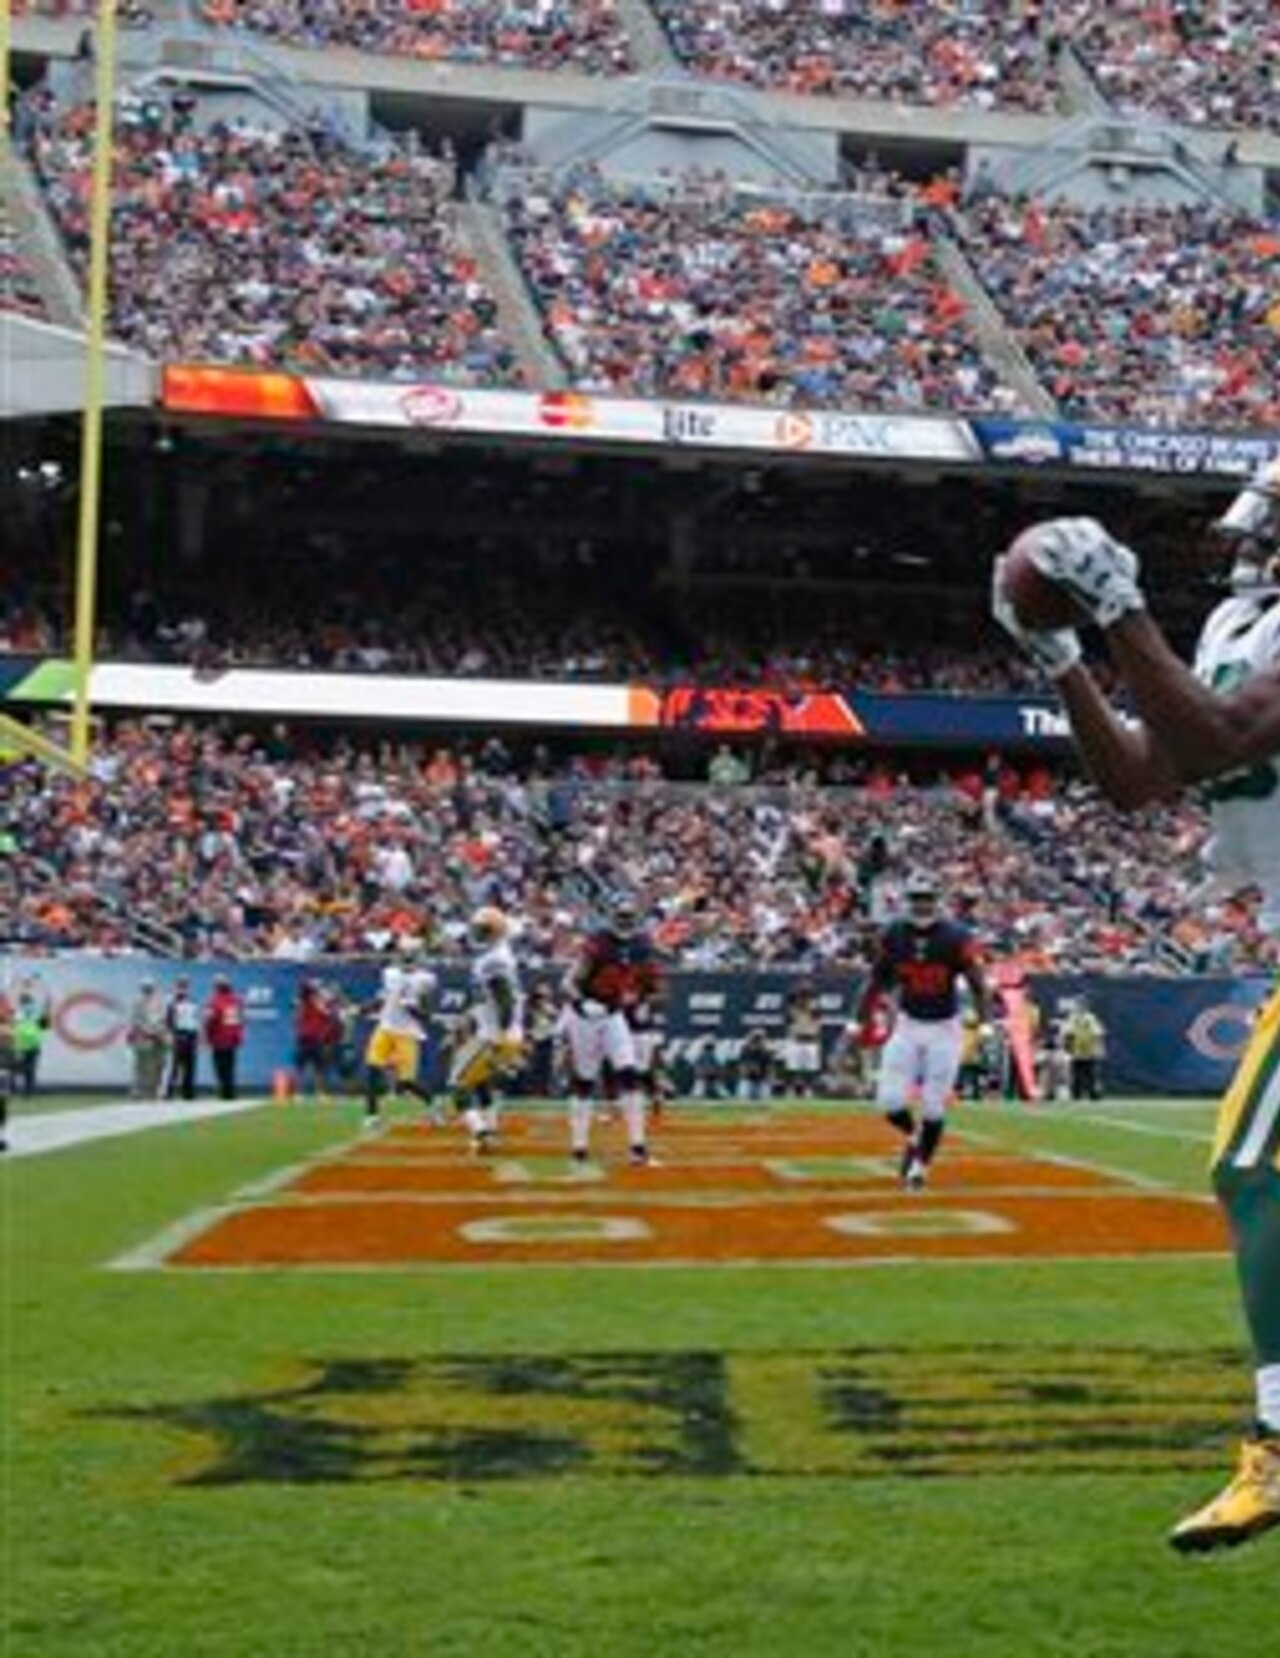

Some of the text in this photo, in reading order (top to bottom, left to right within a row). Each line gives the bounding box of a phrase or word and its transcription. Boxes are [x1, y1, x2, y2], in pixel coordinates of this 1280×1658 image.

[823, 418, 897, 449] PNC
[1083, 430, 1270, 458] THE CHICAGO BEARS
[1175, 453, 1200, 472] OF
